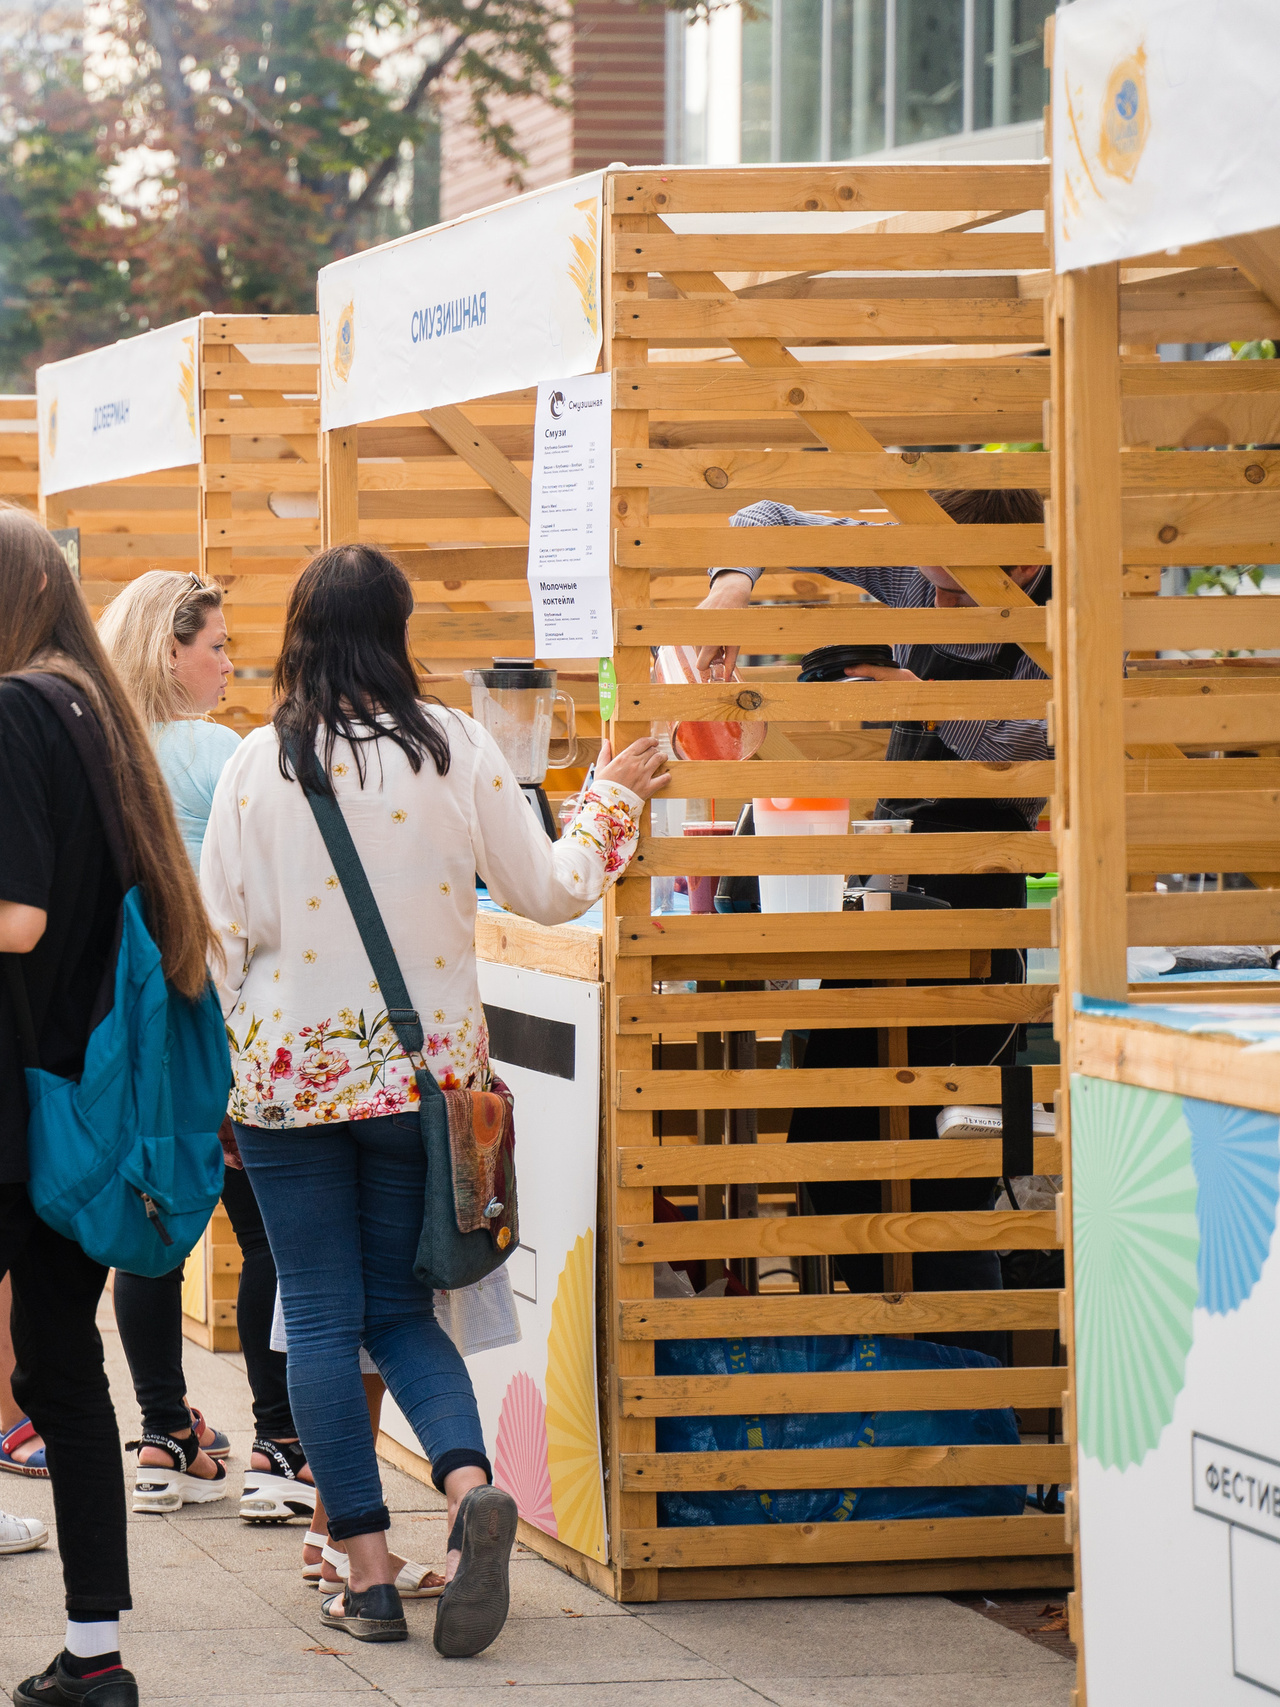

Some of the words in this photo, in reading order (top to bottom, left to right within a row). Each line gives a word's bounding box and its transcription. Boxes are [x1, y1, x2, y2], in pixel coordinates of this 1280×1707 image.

[411, 291, 486, 343] СМУЗИШНАЯ
[569, 399, 603, 412] Смузишная
[545, 429, 567, 440] Смузи
[540, 582, 577, 590] Молочные
[542, 595, 575, 606] коктейли
